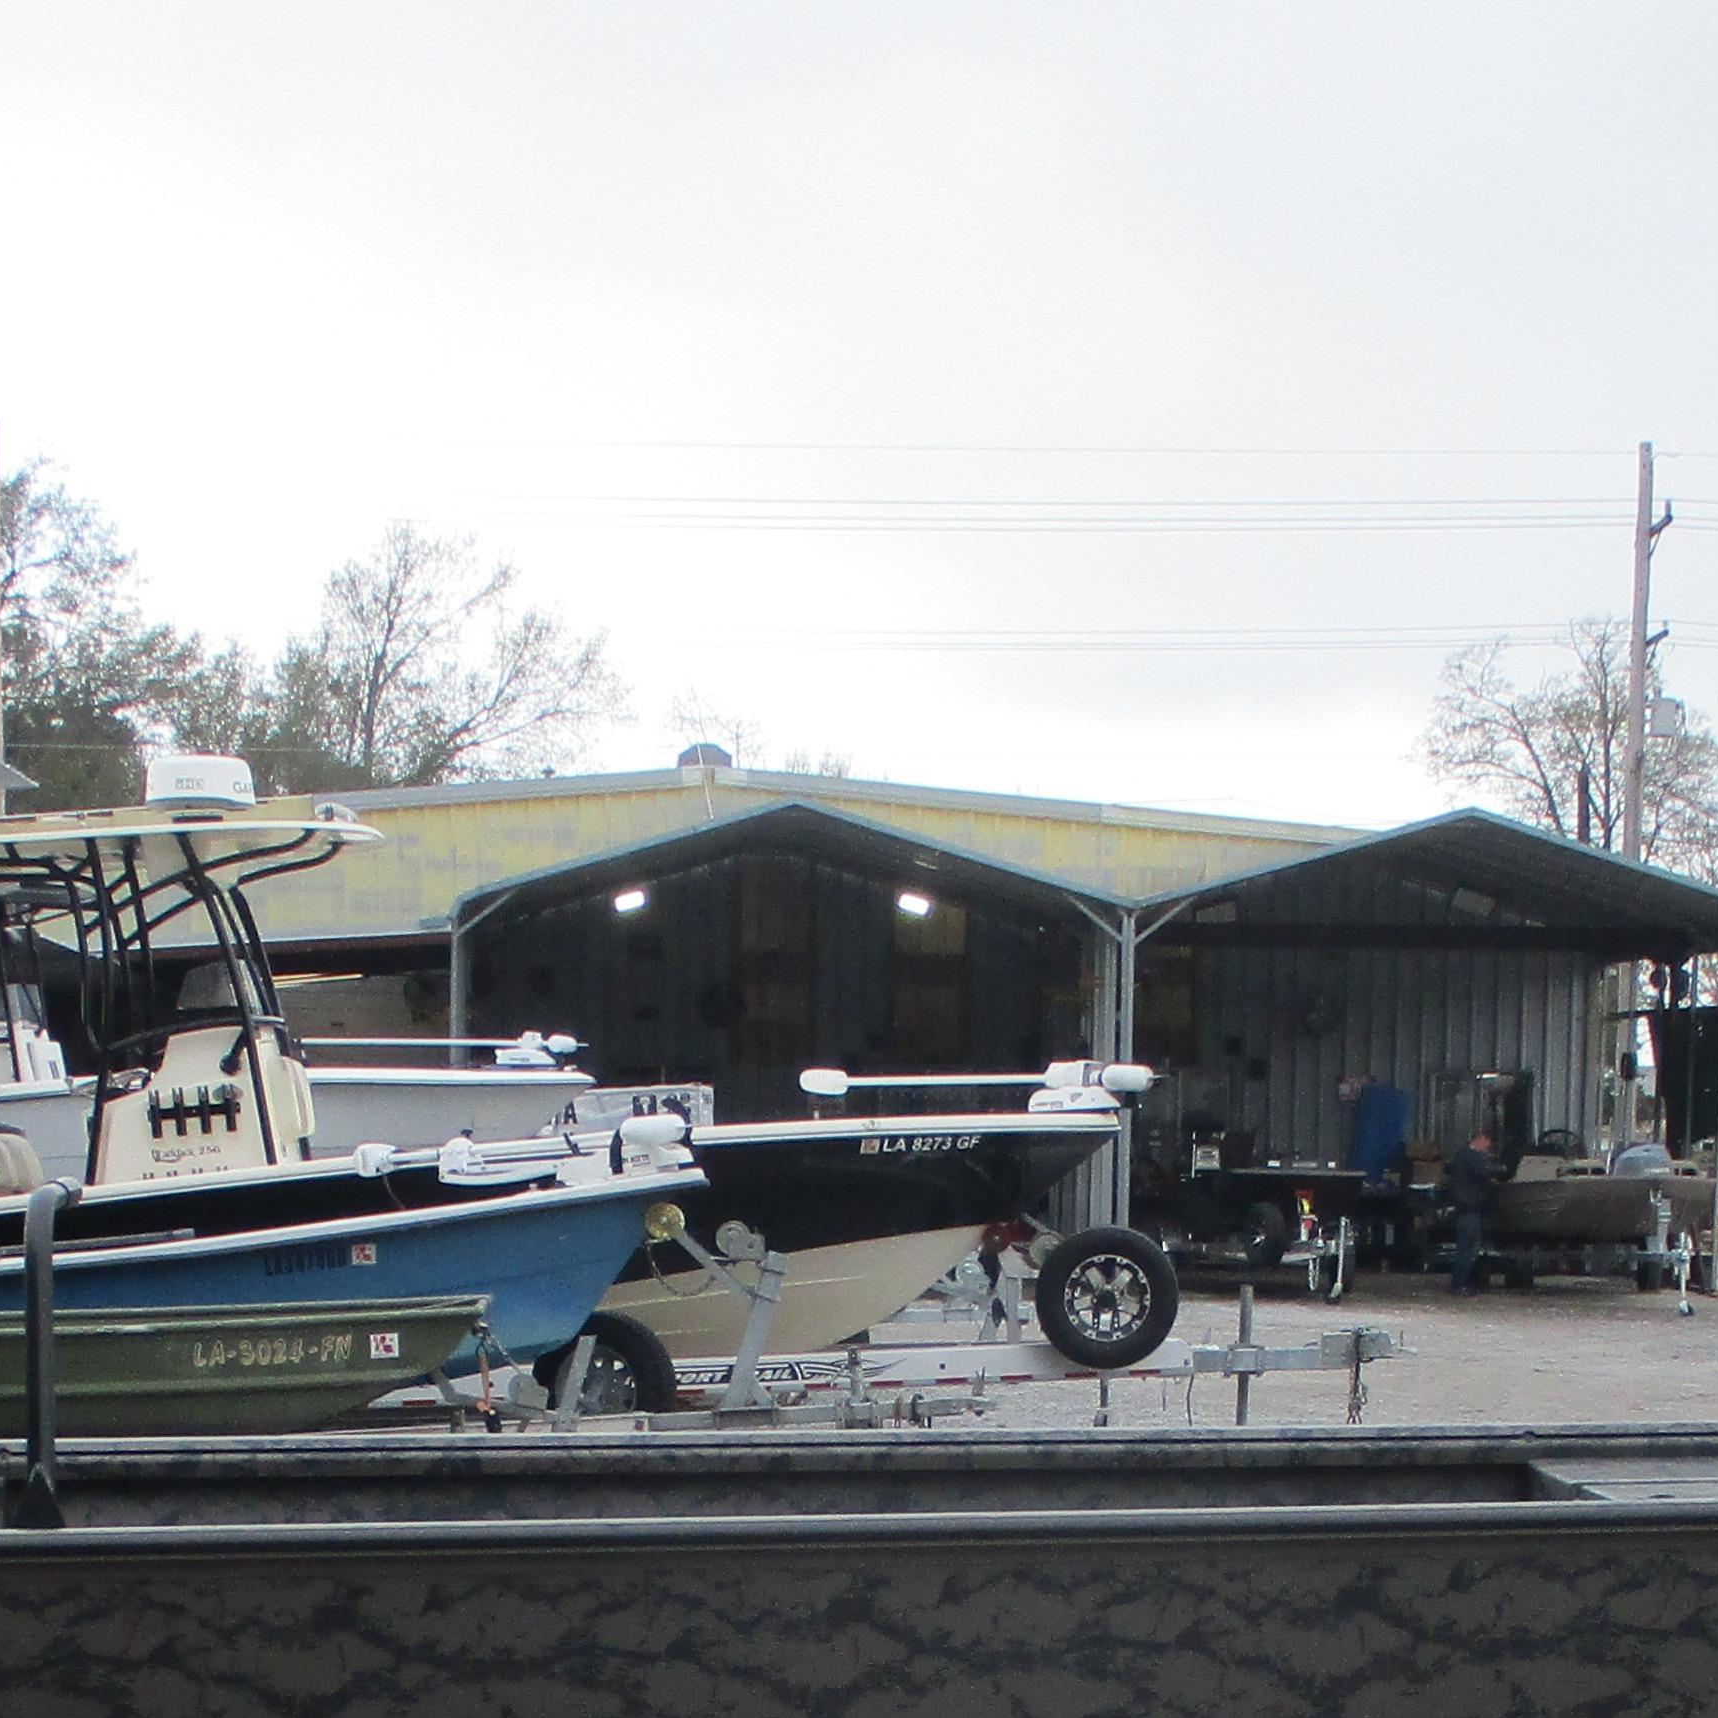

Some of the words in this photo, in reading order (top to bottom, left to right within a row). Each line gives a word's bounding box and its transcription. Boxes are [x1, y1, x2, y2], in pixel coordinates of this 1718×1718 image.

[883, 1137, 907, 1153] LA
[912, 1136, 953, 1152] 8273
[957, 1133, 982, 1150] GF
[674, 1370, 728, 1386] ORT
